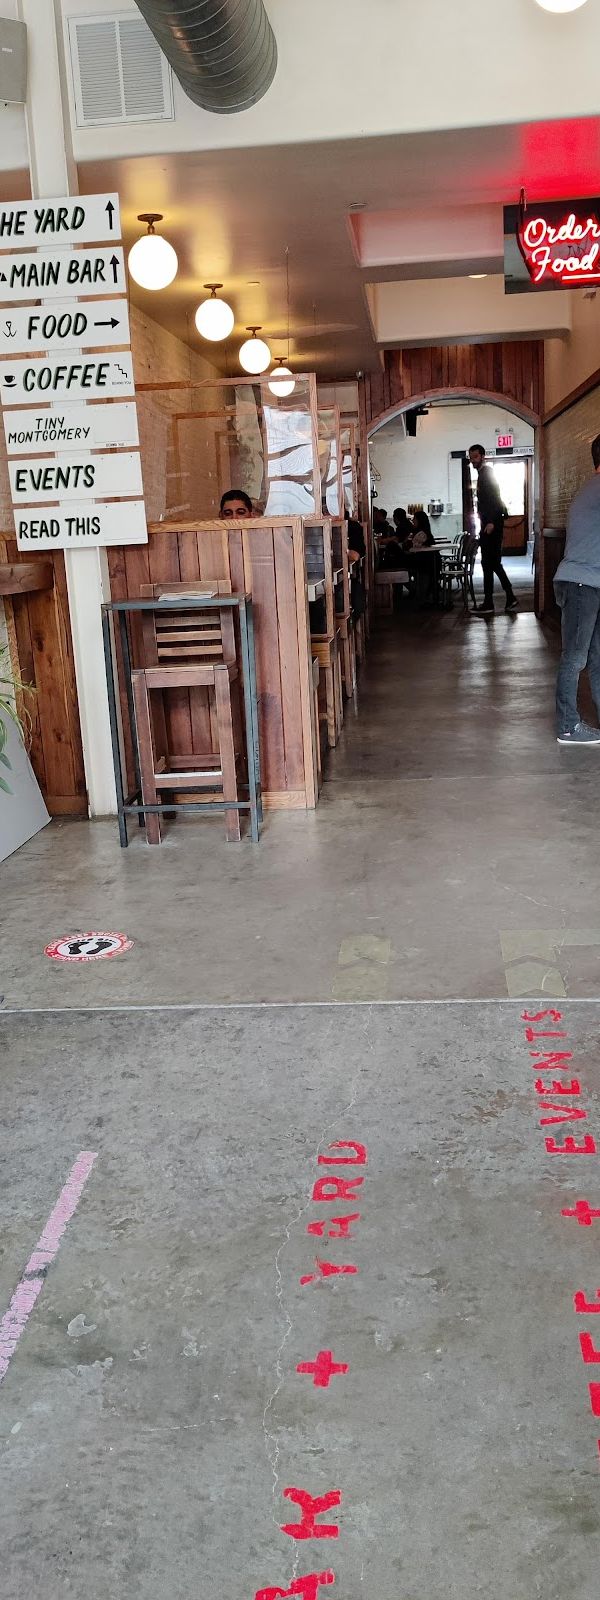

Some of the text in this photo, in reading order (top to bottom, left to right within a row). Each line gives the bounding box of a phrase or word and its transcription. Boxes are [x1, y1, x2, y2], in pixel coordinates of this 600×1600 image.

[34, 206, 86, 234] YARD
[524, 214, 600, 247] Order
[10, 259, 106, 288] MAIN BAR
[531, 243, 599, 281] Food
[28, 313, 87, 340] FOOD
[23, 363, 110, 392] COFFEE
[8, 427, 91, 444] MONTGOMERY
[35, 416, 65, 430] TINY
[498, 435, 512, 447] EXIT
[16, 465, 95, 492] EVENTS
[19, 517, 101, 540] READ THIS
[521, 1009, 597, 1154] EVENTS
[300, 1140, 367, 1286] YARD
